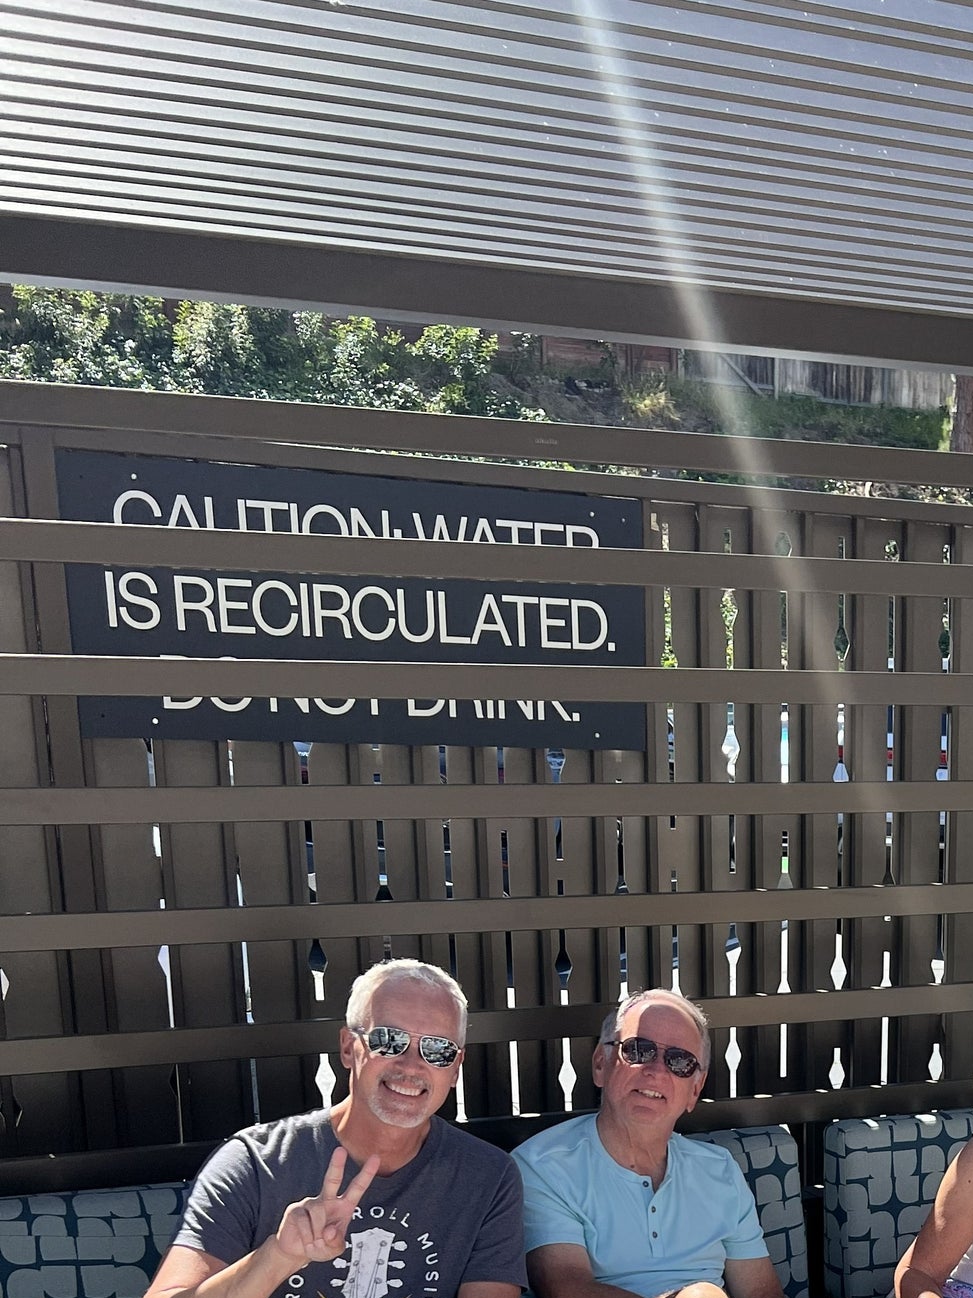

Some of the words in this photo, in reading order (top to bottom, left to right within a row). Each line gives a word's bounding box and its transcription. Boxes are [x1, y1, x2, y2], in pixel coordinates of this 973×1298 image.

[104, 571, 161, 630] IS
[174, 574, 617, 652] RECIRCULATED.
[352, 1205, 411, 1228] ROLL
